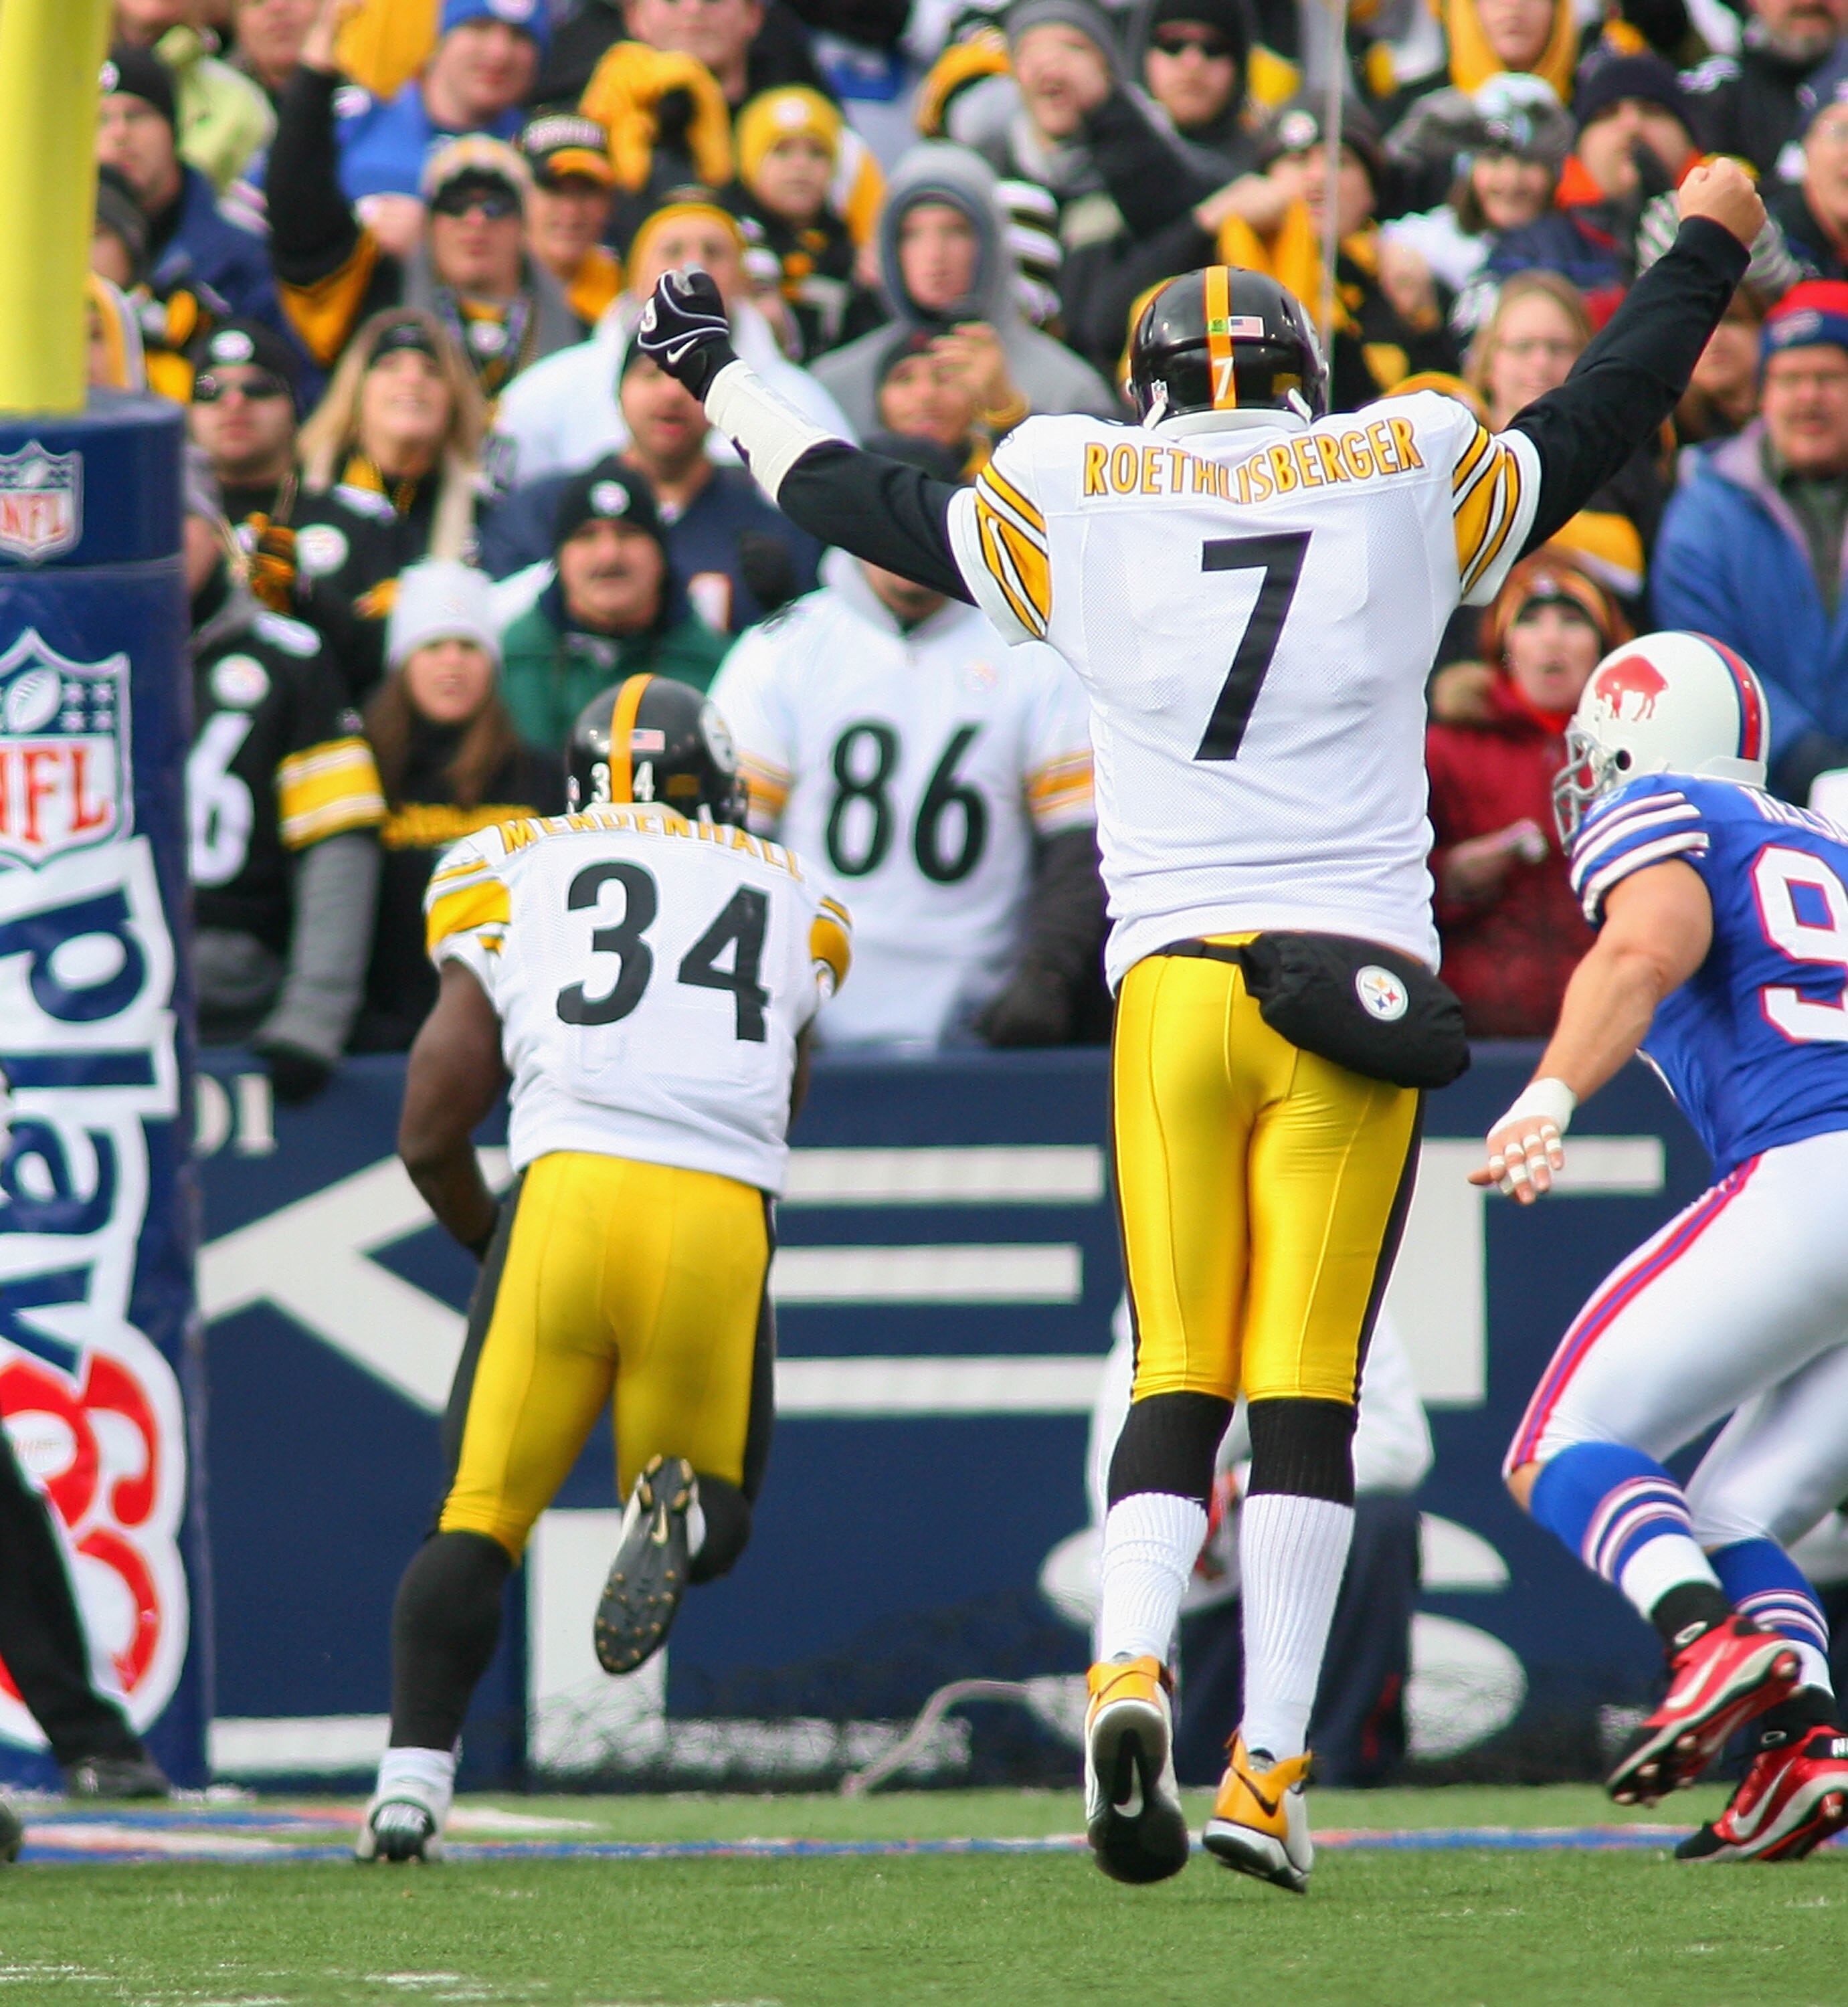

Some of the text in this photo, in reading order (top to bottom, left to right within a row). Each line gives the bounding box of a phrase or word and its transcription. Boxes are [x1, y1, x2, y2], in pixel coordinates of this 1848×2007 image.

[1213, 356, 1234, 401] 7
[1083, 417, 1424, 504] ROETHLISBERGER
[1192, 530, 1313, 761] 7
[826, 721, 989, 884] 86
[556, 860, 771, 1042] 34
